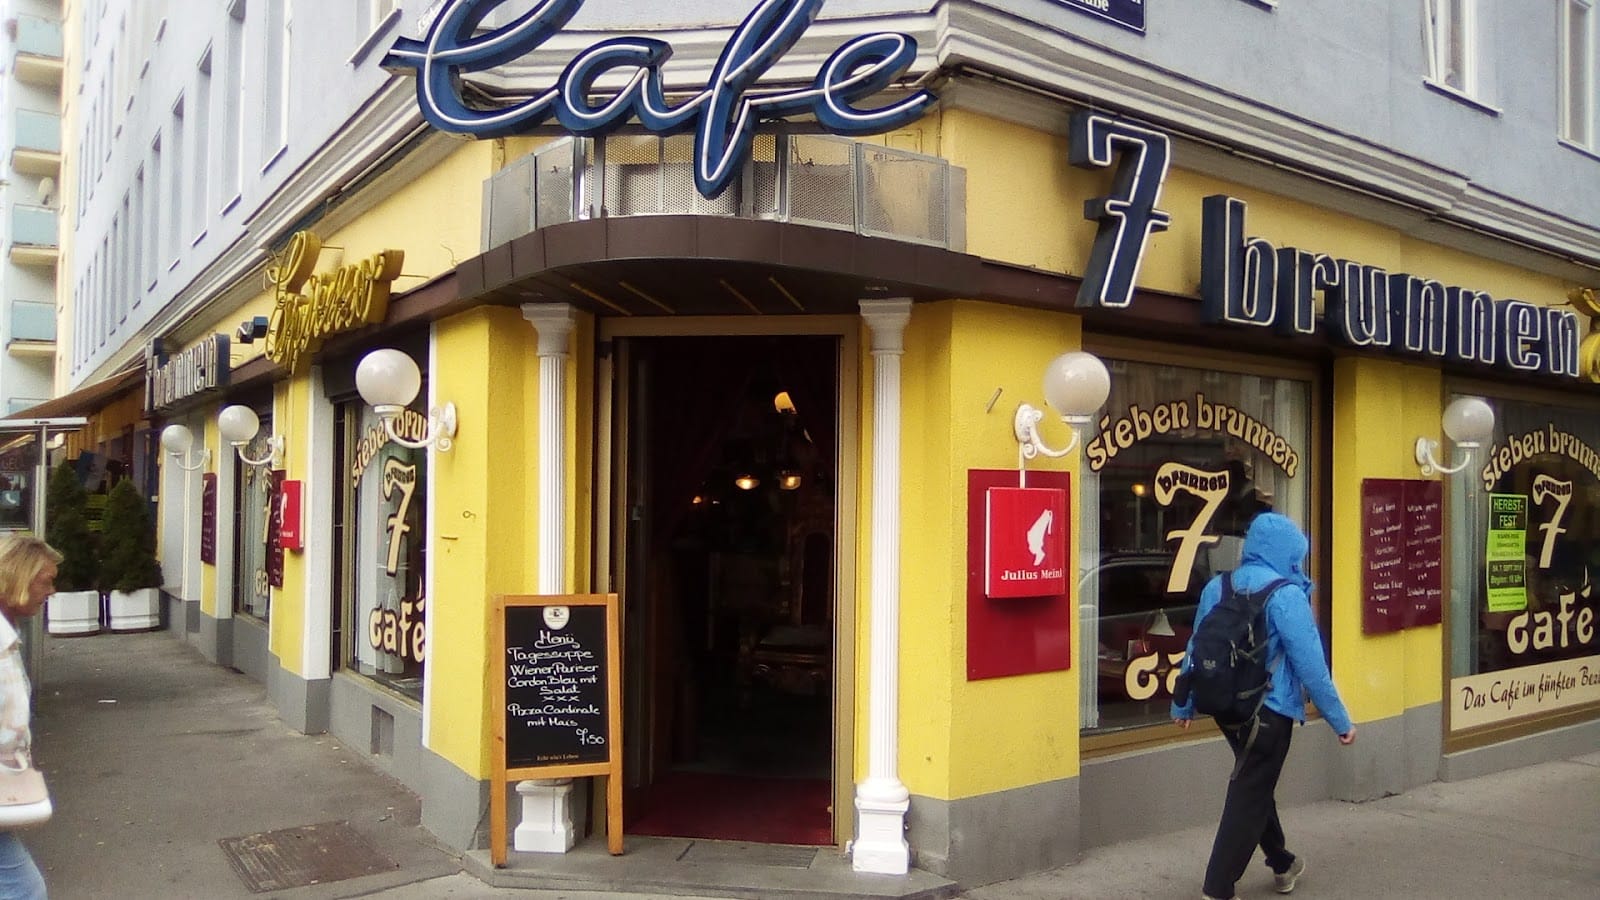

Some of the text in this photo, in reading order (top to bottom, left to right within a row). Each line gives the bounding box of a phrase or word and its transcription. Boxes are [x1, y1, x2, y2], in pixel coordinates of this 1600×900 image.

[1074, 112, 1171, 309] 7
[1203, 194, 1581, 379] brunnen
[1086, 393, 1300, 478] sieben brunnen
[1482, 422, 1600, 492] sieben brunn
[1157, 470, 1228, 496] brunnen
[383, 455, 417, 575] 7
[1154, 461, 1231, 593] 7
[1500, 515, 1518, 528] FEST
[1532, 473, 1573, 569] 7
[1001, 568, 1063, 581] Julius Meinl
[1506, 584, 1594, 655] café
[536, 630, 580, 648] Menü
[507, 647, 594, 665] Tagessuppe
[508, 676, 547, 688] Cordon
[579, 674, 598, 684] mit
[539, 684, 581, 695] Salat
[1461, 686, 1486, 711] Das
[1490, 681, 1520, 710] Café
[1522, 681, 1535, 699] im
[1537, 671, 1576, 703] fünften
[507, 703, 601, 716] Pizza Cardinale
[526, 716, 547, 727] mit
